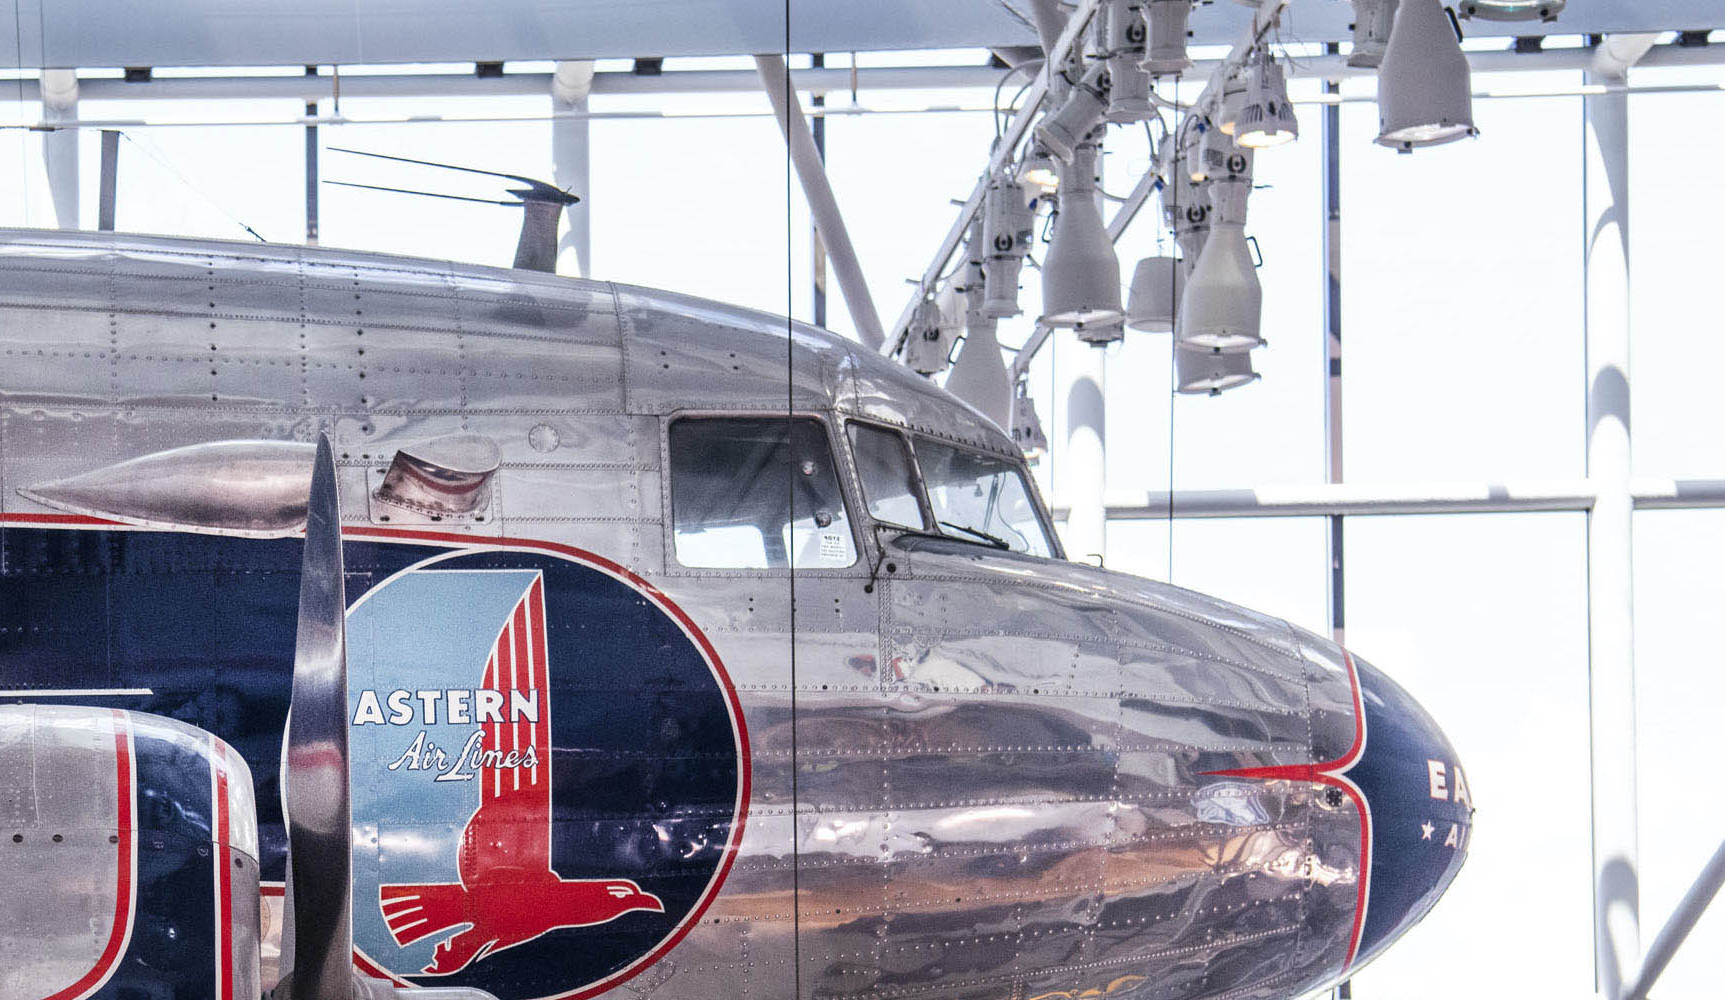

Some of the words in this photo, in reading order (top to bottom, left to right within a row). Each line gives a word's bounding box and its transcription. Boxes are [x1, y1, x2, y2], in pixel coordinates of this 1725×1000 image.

[352, 689, 540, 726] ASTERN
[387, 730, 449, 771] Air
[434, 730, 539, 782] Lines
